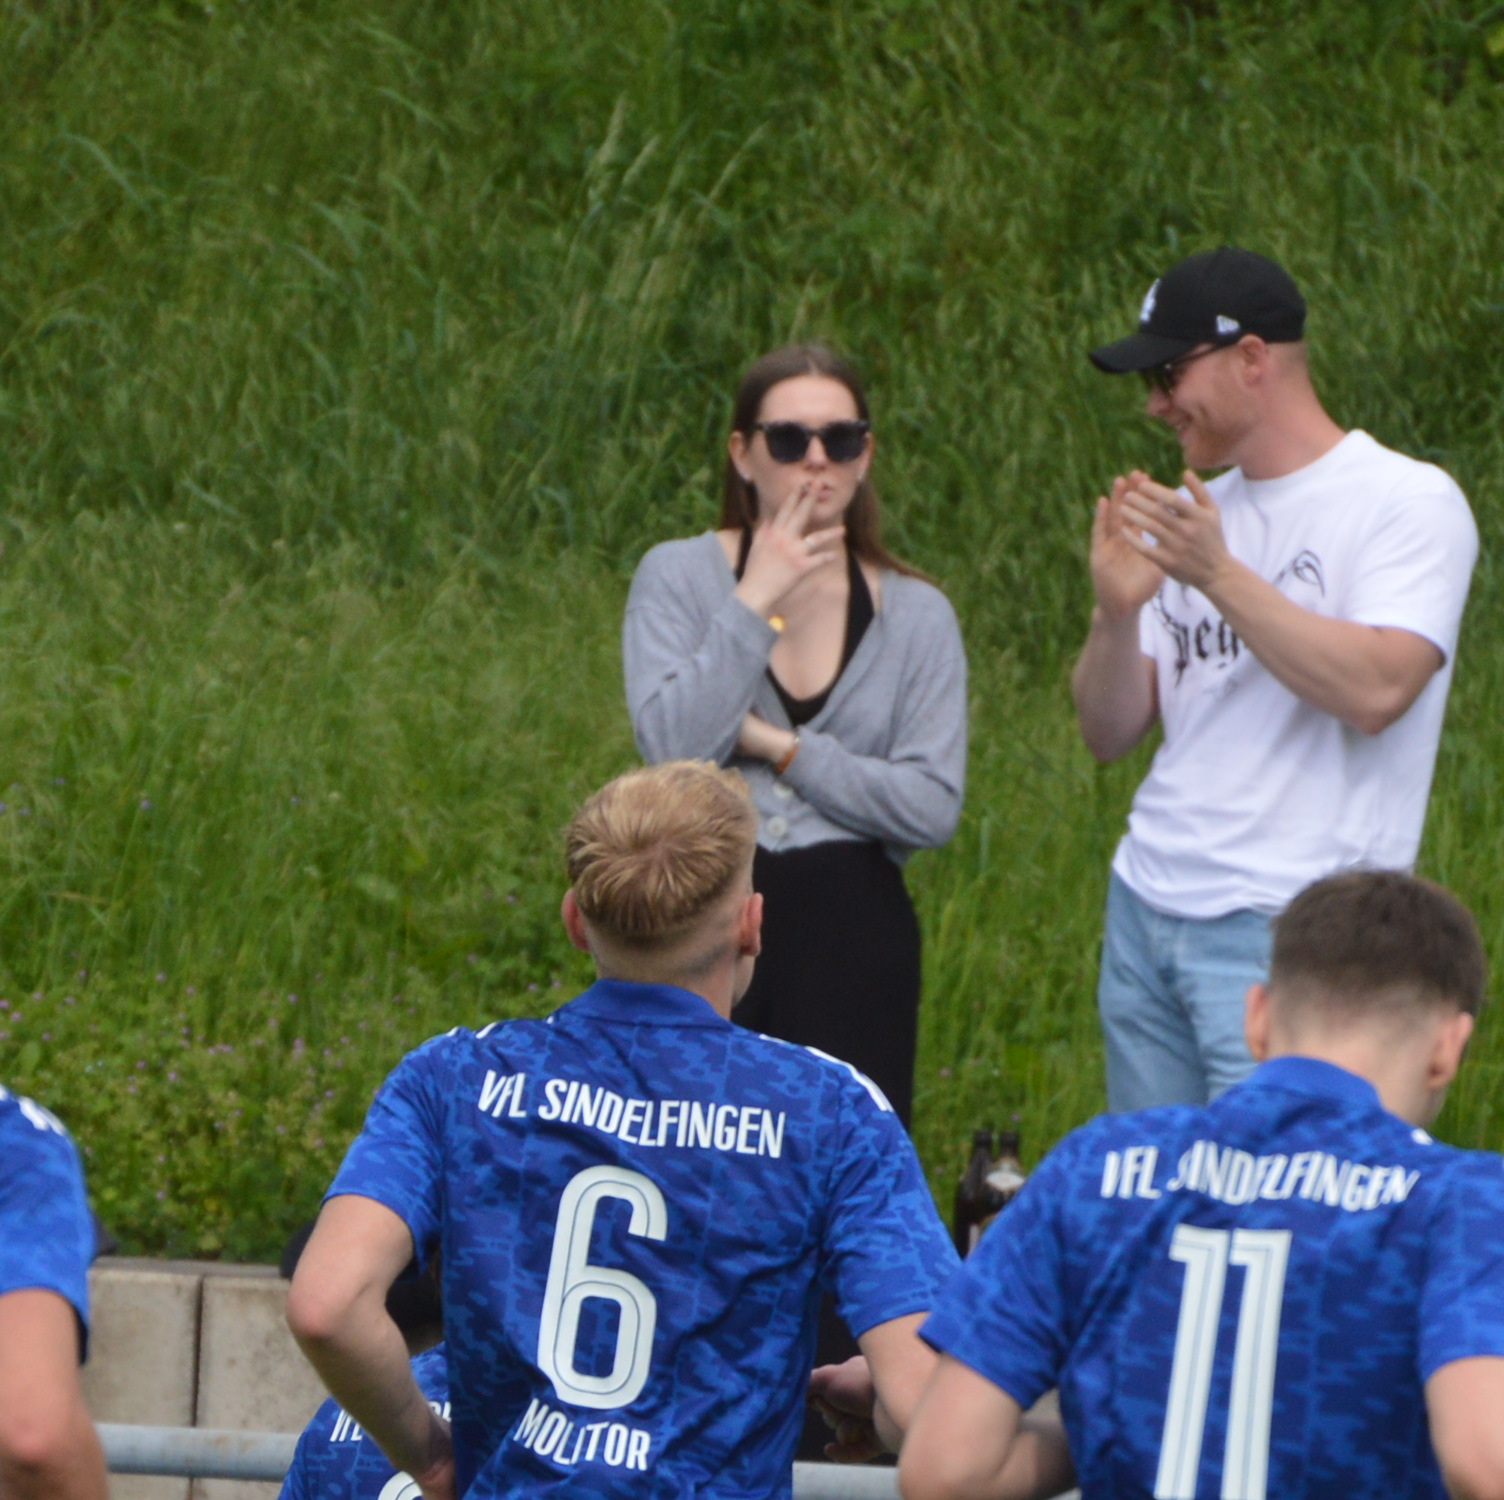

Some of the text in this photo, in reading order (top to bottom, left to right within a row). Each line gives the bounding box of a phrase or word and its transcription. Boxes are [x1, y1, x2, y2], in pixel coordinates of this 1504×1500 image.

[538, 1078, 786, 1159] SINDELFINGEN
[536, 1165, 669, 1409] 6
[513, 1398, 651, 1471] MOLITOR
